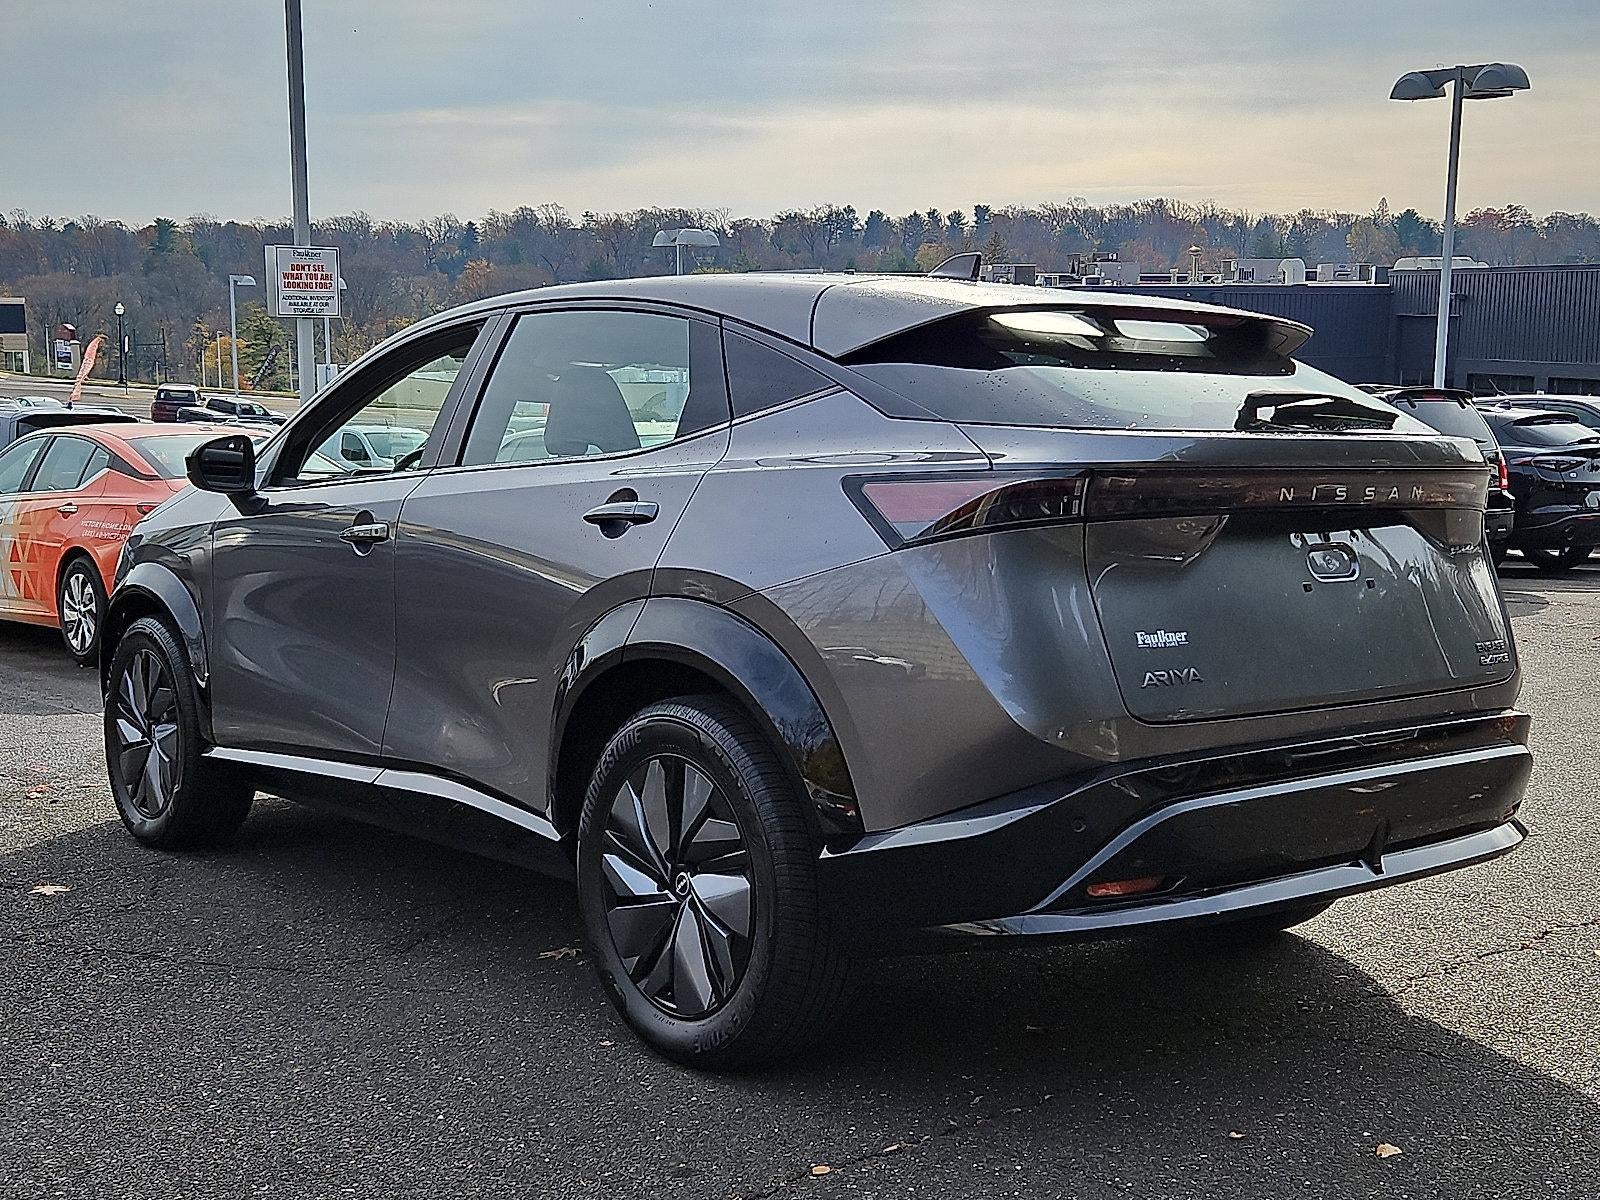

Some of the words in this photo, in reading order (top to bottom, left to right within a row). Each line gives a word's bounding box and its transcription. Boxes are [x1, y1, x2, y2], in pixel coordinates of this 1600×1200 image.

[292, 250, 322, 258] Faulkner
[290, 264, 311, 272] DON'T
[313, 264, 325, 272] SEE
[282, 272, 303, 280] WHAT
[305, 273, 318, 281] YOU
[319, 273, 334, 281] ARE
[283, 281, 314, 290] LOOKING
[315, 282, 333, 290] FOR?
[1279, 486, 1423, 501] NISSAN
[1135, 630, 1188, 644] Faulkner
[1141, 667, 1205, 688] ARIYA
[580, 726, 642, 834] BRIDGESTONE
